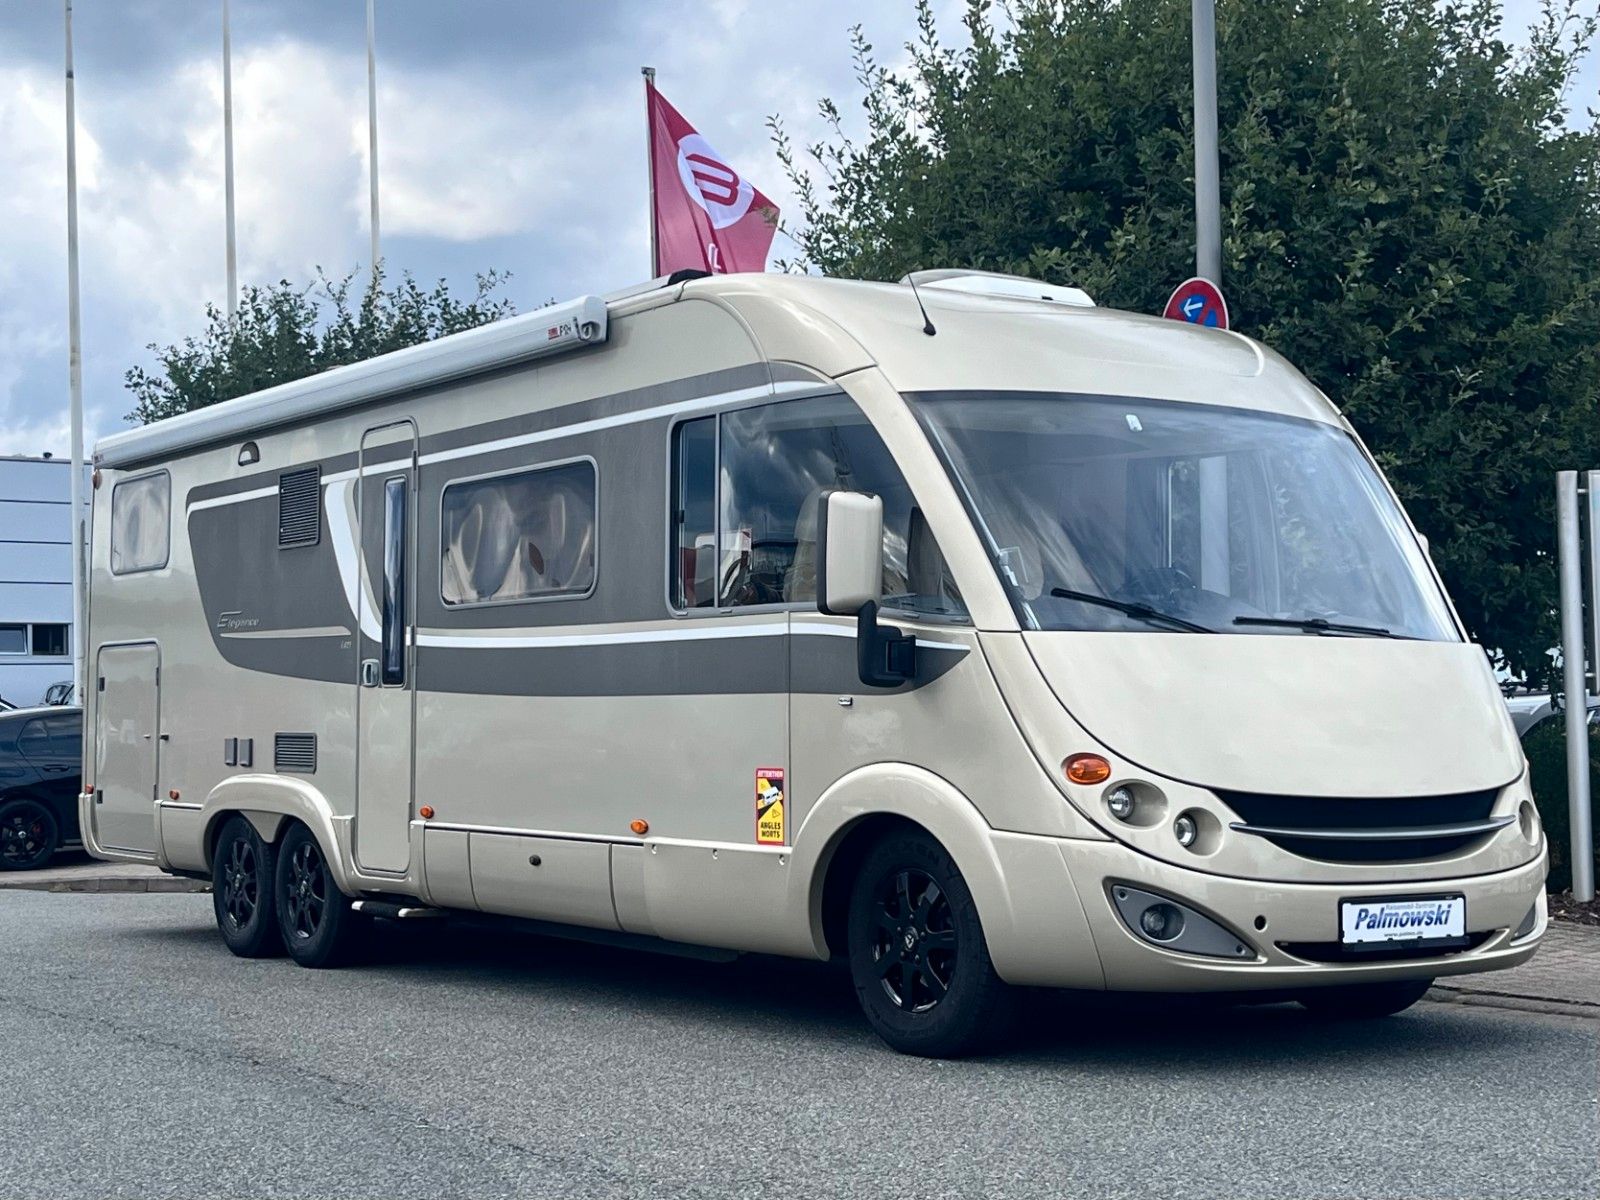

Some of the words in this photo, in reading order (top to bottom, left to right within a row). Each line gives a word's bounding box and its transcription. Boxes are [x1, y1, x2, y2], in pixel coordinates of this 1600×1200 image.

[761, 821, 781, 830] ANGLES
[761, 830, 781, 839] MORTS
[1354, 903, 1452, 930] Palmowski
